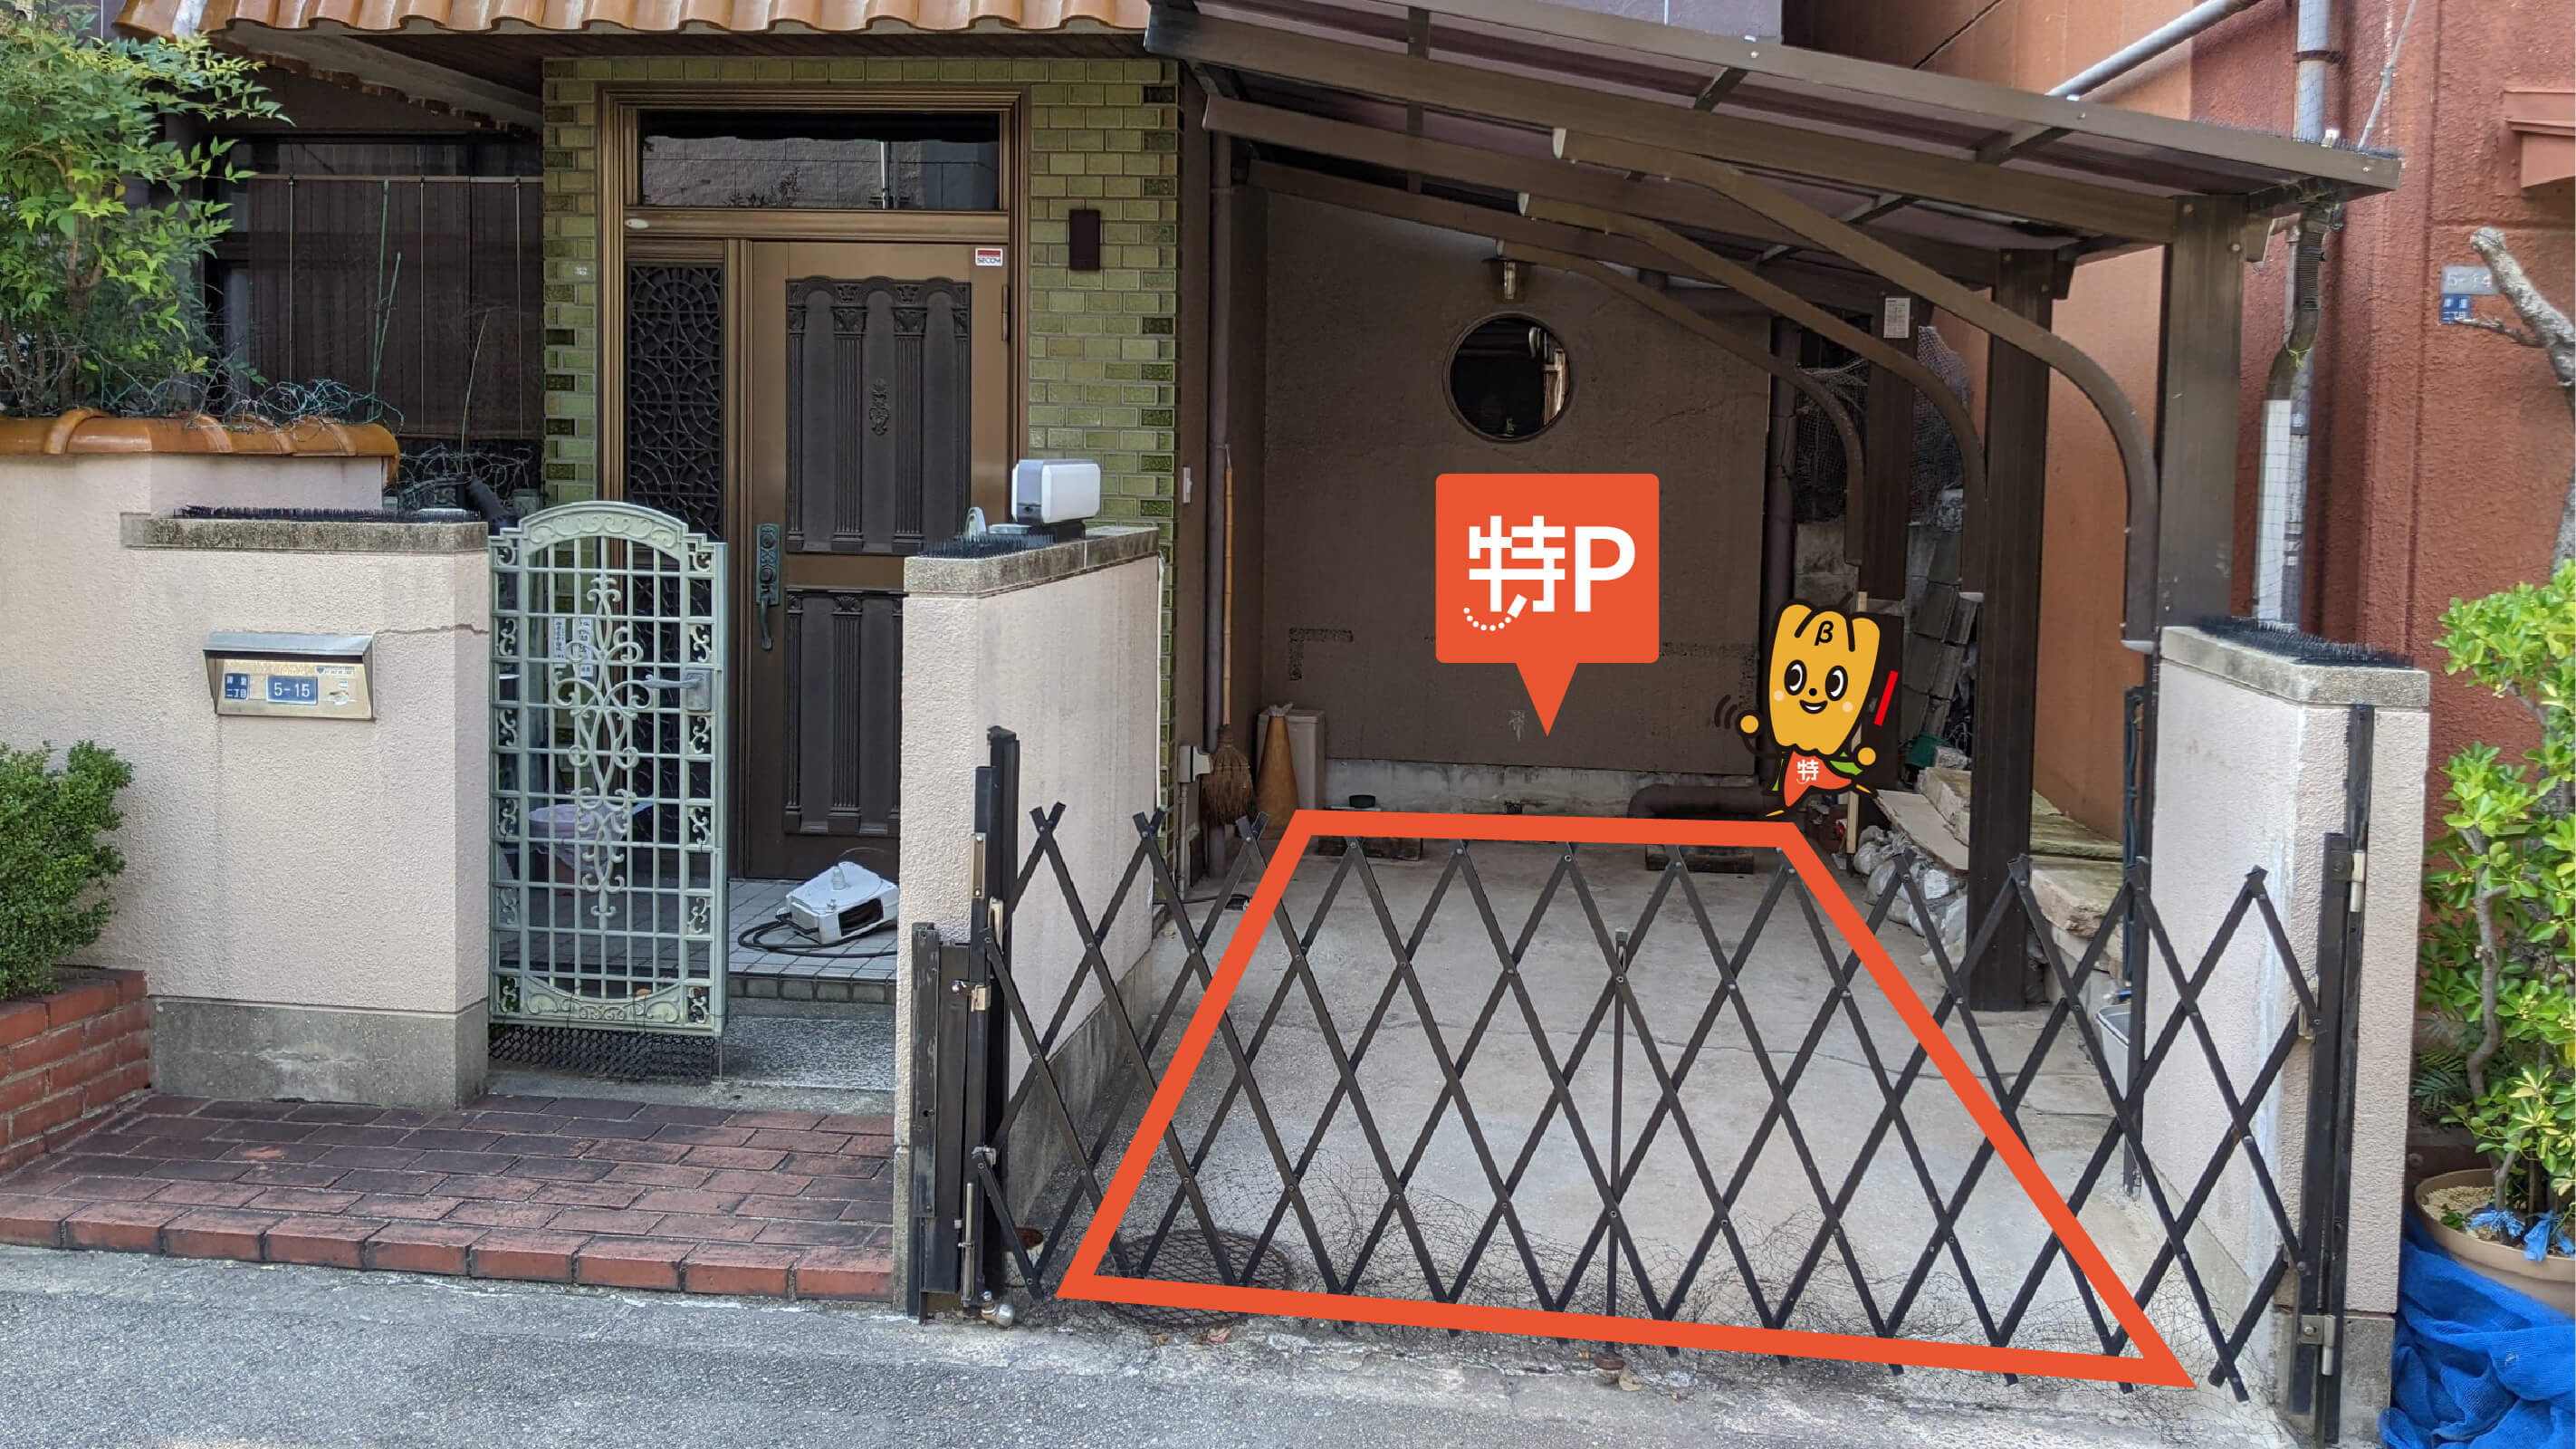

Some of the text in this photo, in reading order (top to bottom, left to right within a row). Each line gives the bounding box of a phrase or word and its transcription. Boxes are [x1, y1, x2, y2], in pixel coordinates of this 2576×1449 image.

[226, 688, 247, 698] 二丁目
[274, 682, 311, 697] 5-15
